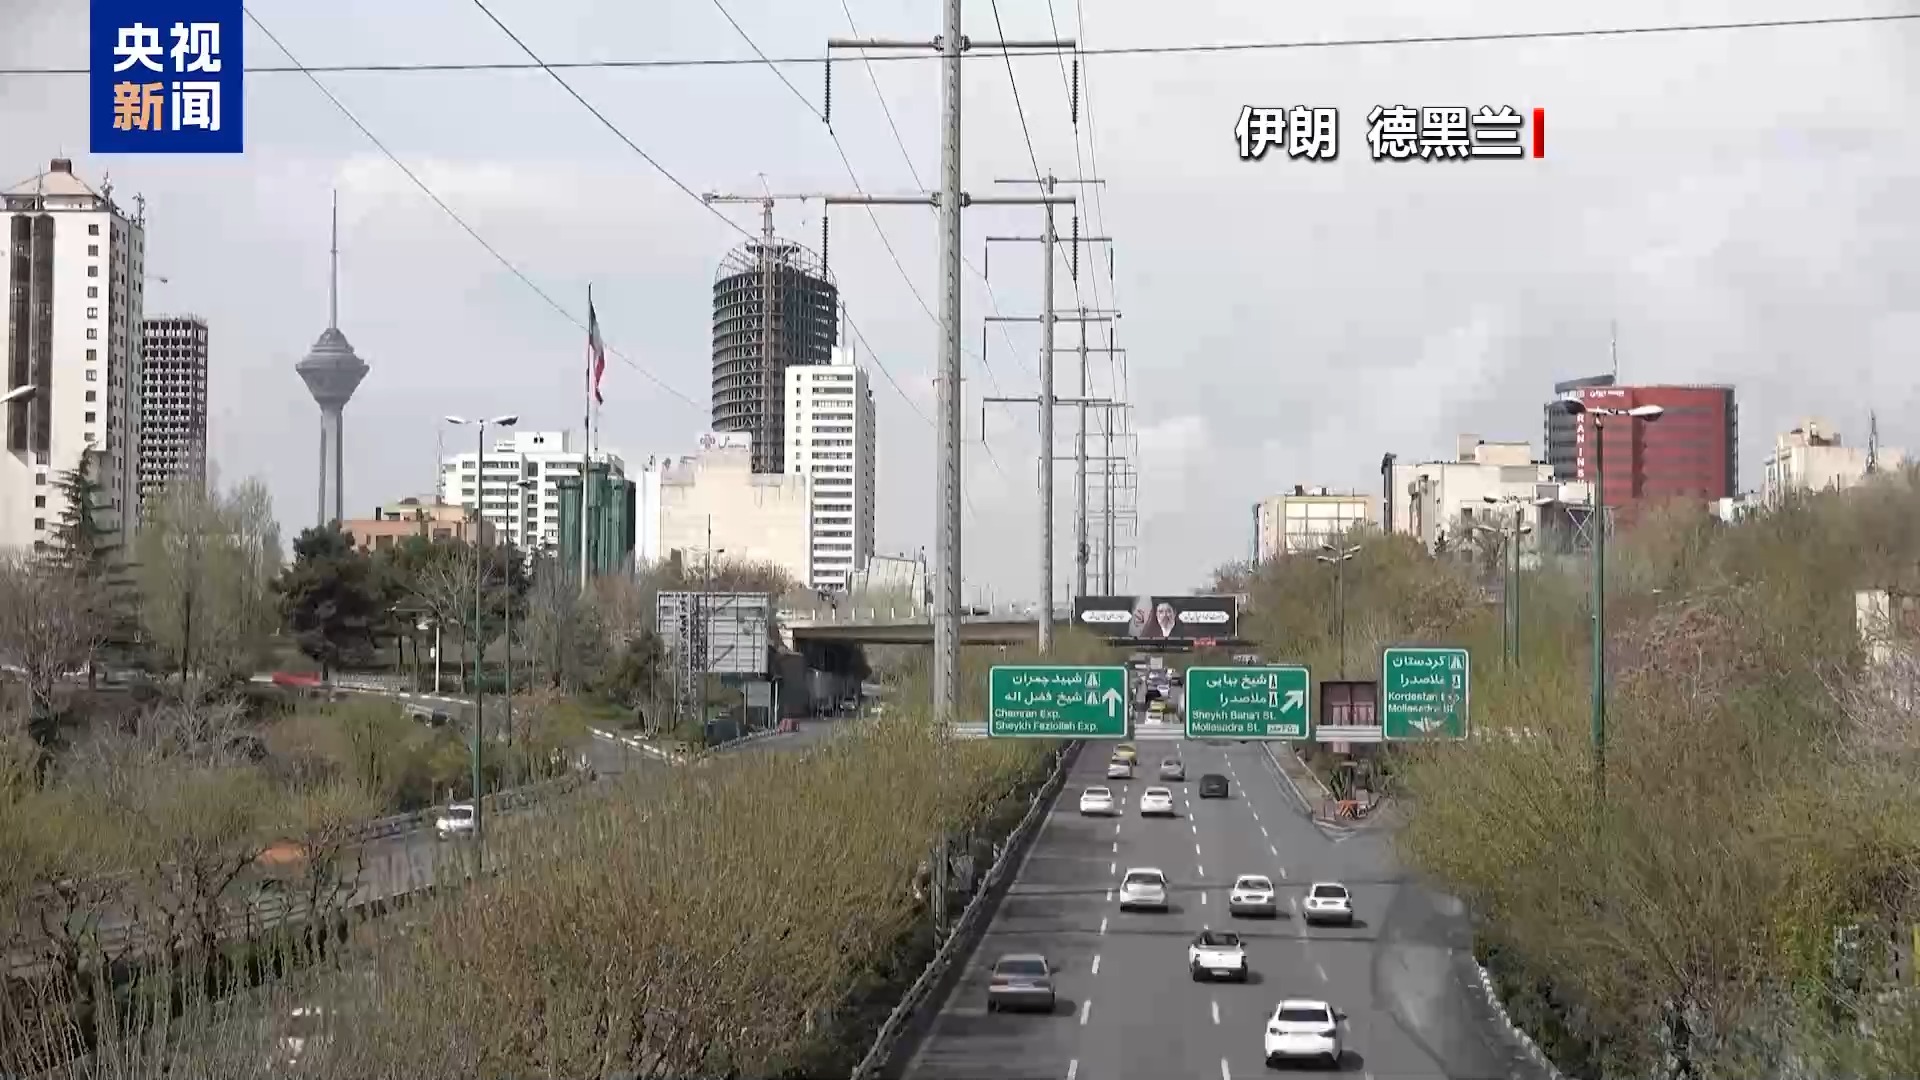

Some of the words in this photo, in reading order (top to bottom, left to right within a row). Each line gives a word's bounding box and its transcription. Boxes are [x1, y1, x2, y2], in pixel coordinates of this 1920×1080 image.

[1392, 655, 1446, 669] کردستان
[1012, 672, 1049, 687] چمران
[1051, 673, 1082, 686] شهید
[1206, 673, 1238, 688] بهایی
[1241, 673, 1267, 689] شیخ
[1024, 691, 1052, 705] فضل
[1056, 691, 1082, 706] شیخ
[1220, 691, 1267, 707] ملاصدرا
[994, 708, 1037, 719] Chamran
[1040, 708, 1061, 721] Exp.
[1192, 710, 1228, 721] Sheykh
[995, 720, 1031, 732] Sheykh
[1077, 721, 1099, 733] Exp.
[1191, 723, 1244, 732] Mollasadra
